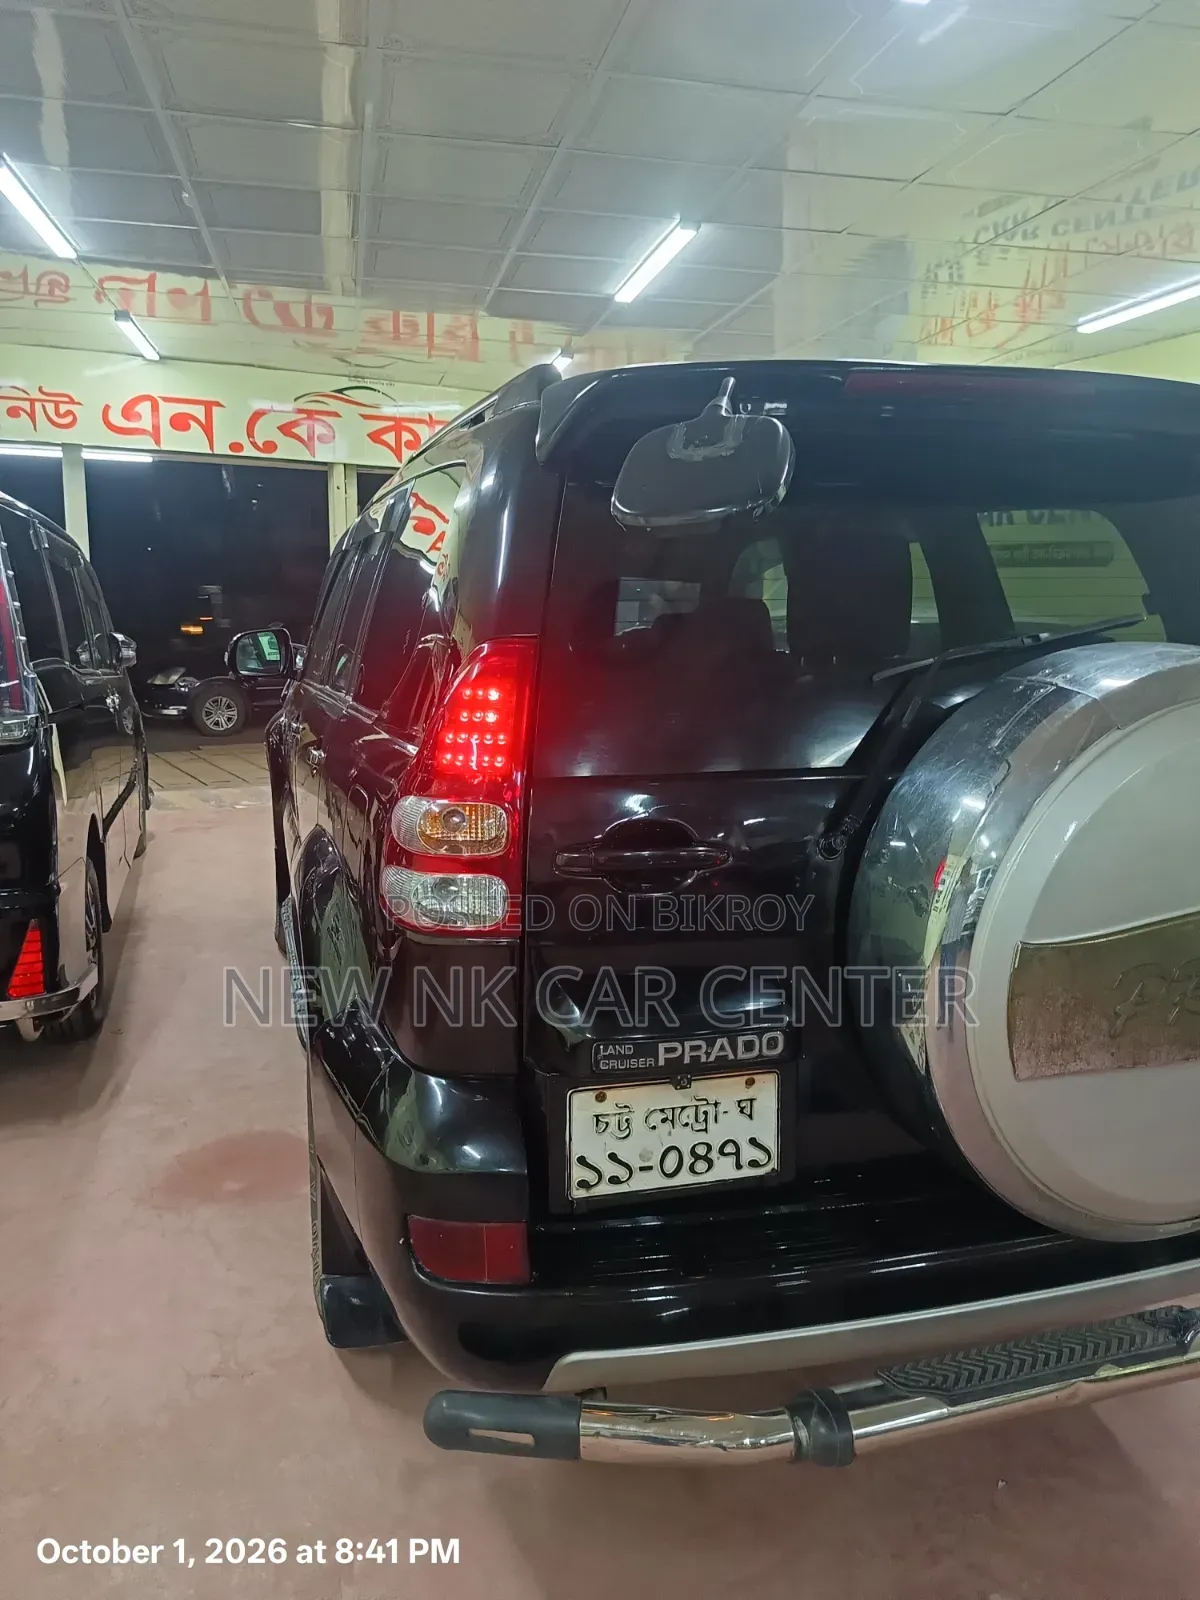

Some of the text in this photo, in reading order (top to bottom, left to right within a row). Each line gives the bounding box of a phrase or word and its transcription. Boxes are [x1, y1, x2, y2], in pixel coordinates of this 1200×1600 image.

[358, 412, 450, 464] কা
[599, 1044, 634, 1056] LAND
[599, 1057, 655, 1070] CRUISER
[658, 1031, 785, 1066] PRADO
[575, 1137, 772, 1190] ১১-০৪৭১
